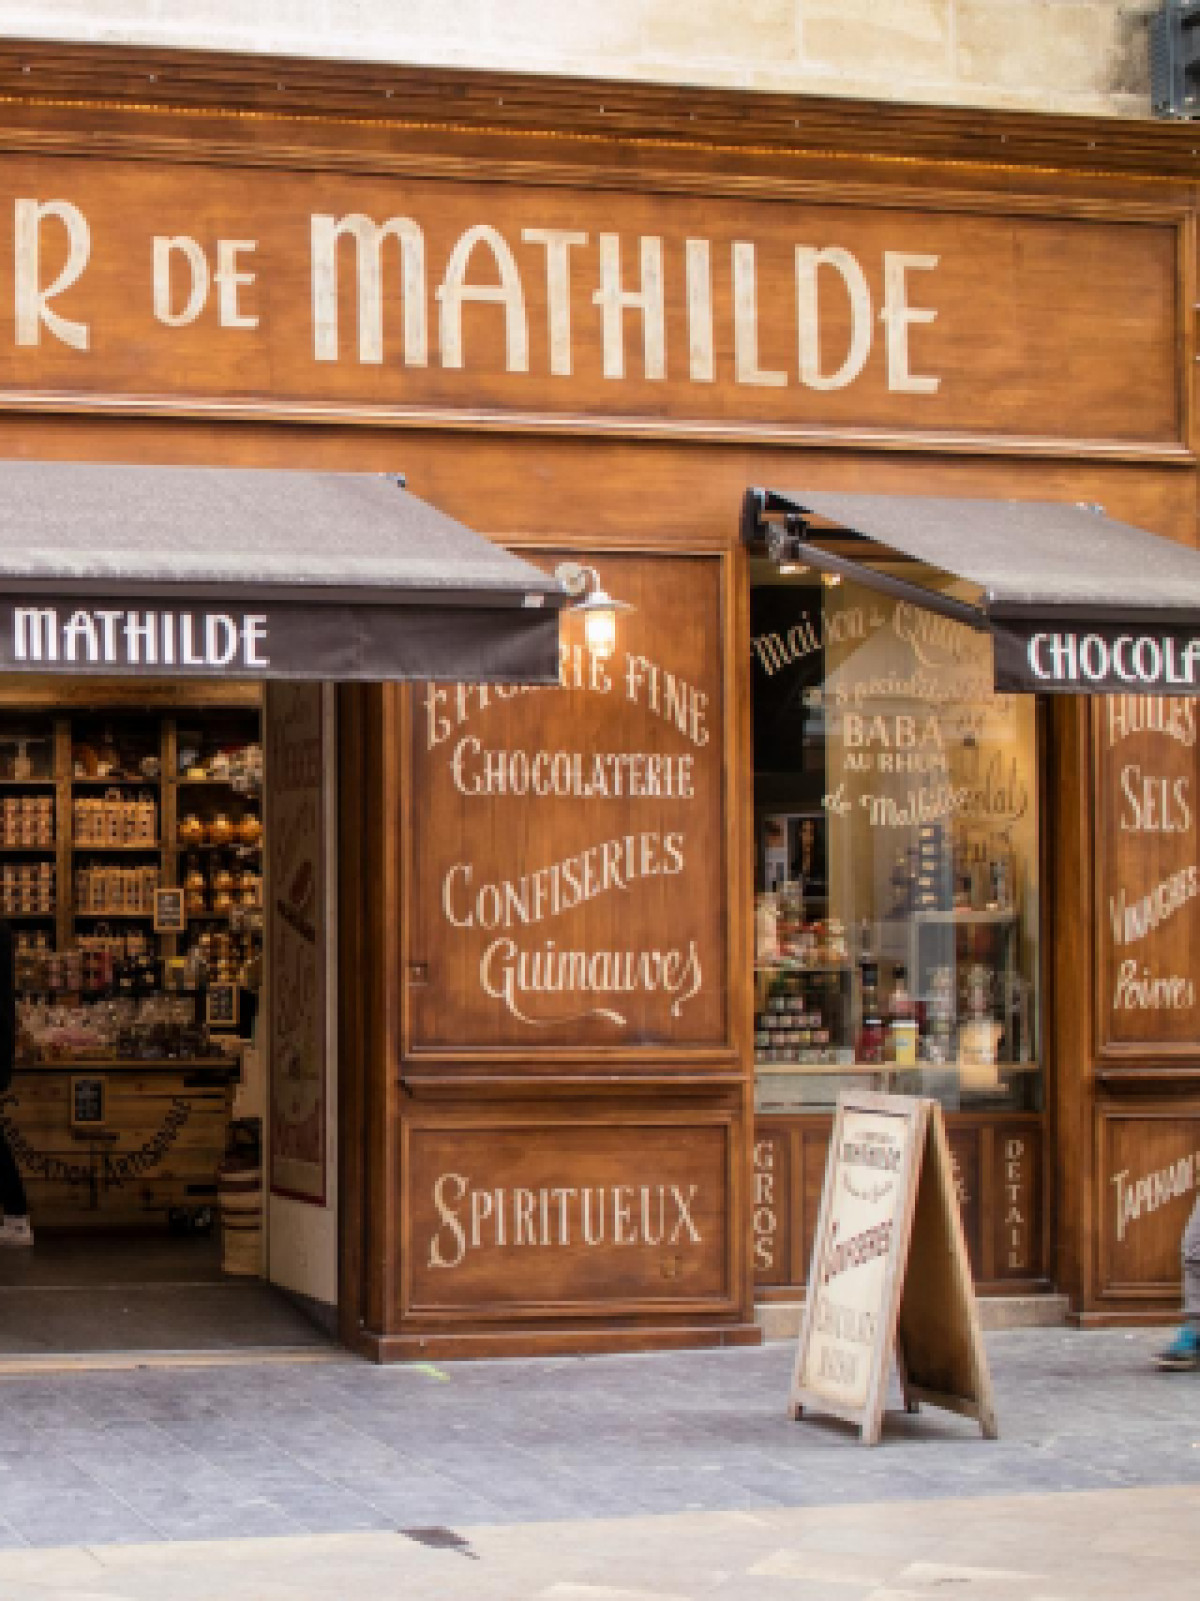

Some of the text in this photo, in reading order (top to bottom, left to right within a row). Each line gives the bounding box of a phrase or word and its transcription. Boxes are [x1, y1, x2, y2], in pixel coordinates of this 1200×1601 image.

[153, 235, 259, 329] DE
[311, 212, 941, 394] MATHILDE
[13, 606, 270, 666] MATHILDE
[626, 651, 710, 747] FINE
[843, 714, 943, 747] BABA
[450, 734, 695, 799] CHOCOLATERIE
[844, 753, 946, 772] AU RHUM
[1120, 765, 1193, 832] SELS
[442, 832, 684, 930] CONFISERIES
[480, 936, 702, 1026] Guimauves
[428, 1173, 702, 1269] SPIRITUEUX
[753, 1139, 777, 1270] GROS
